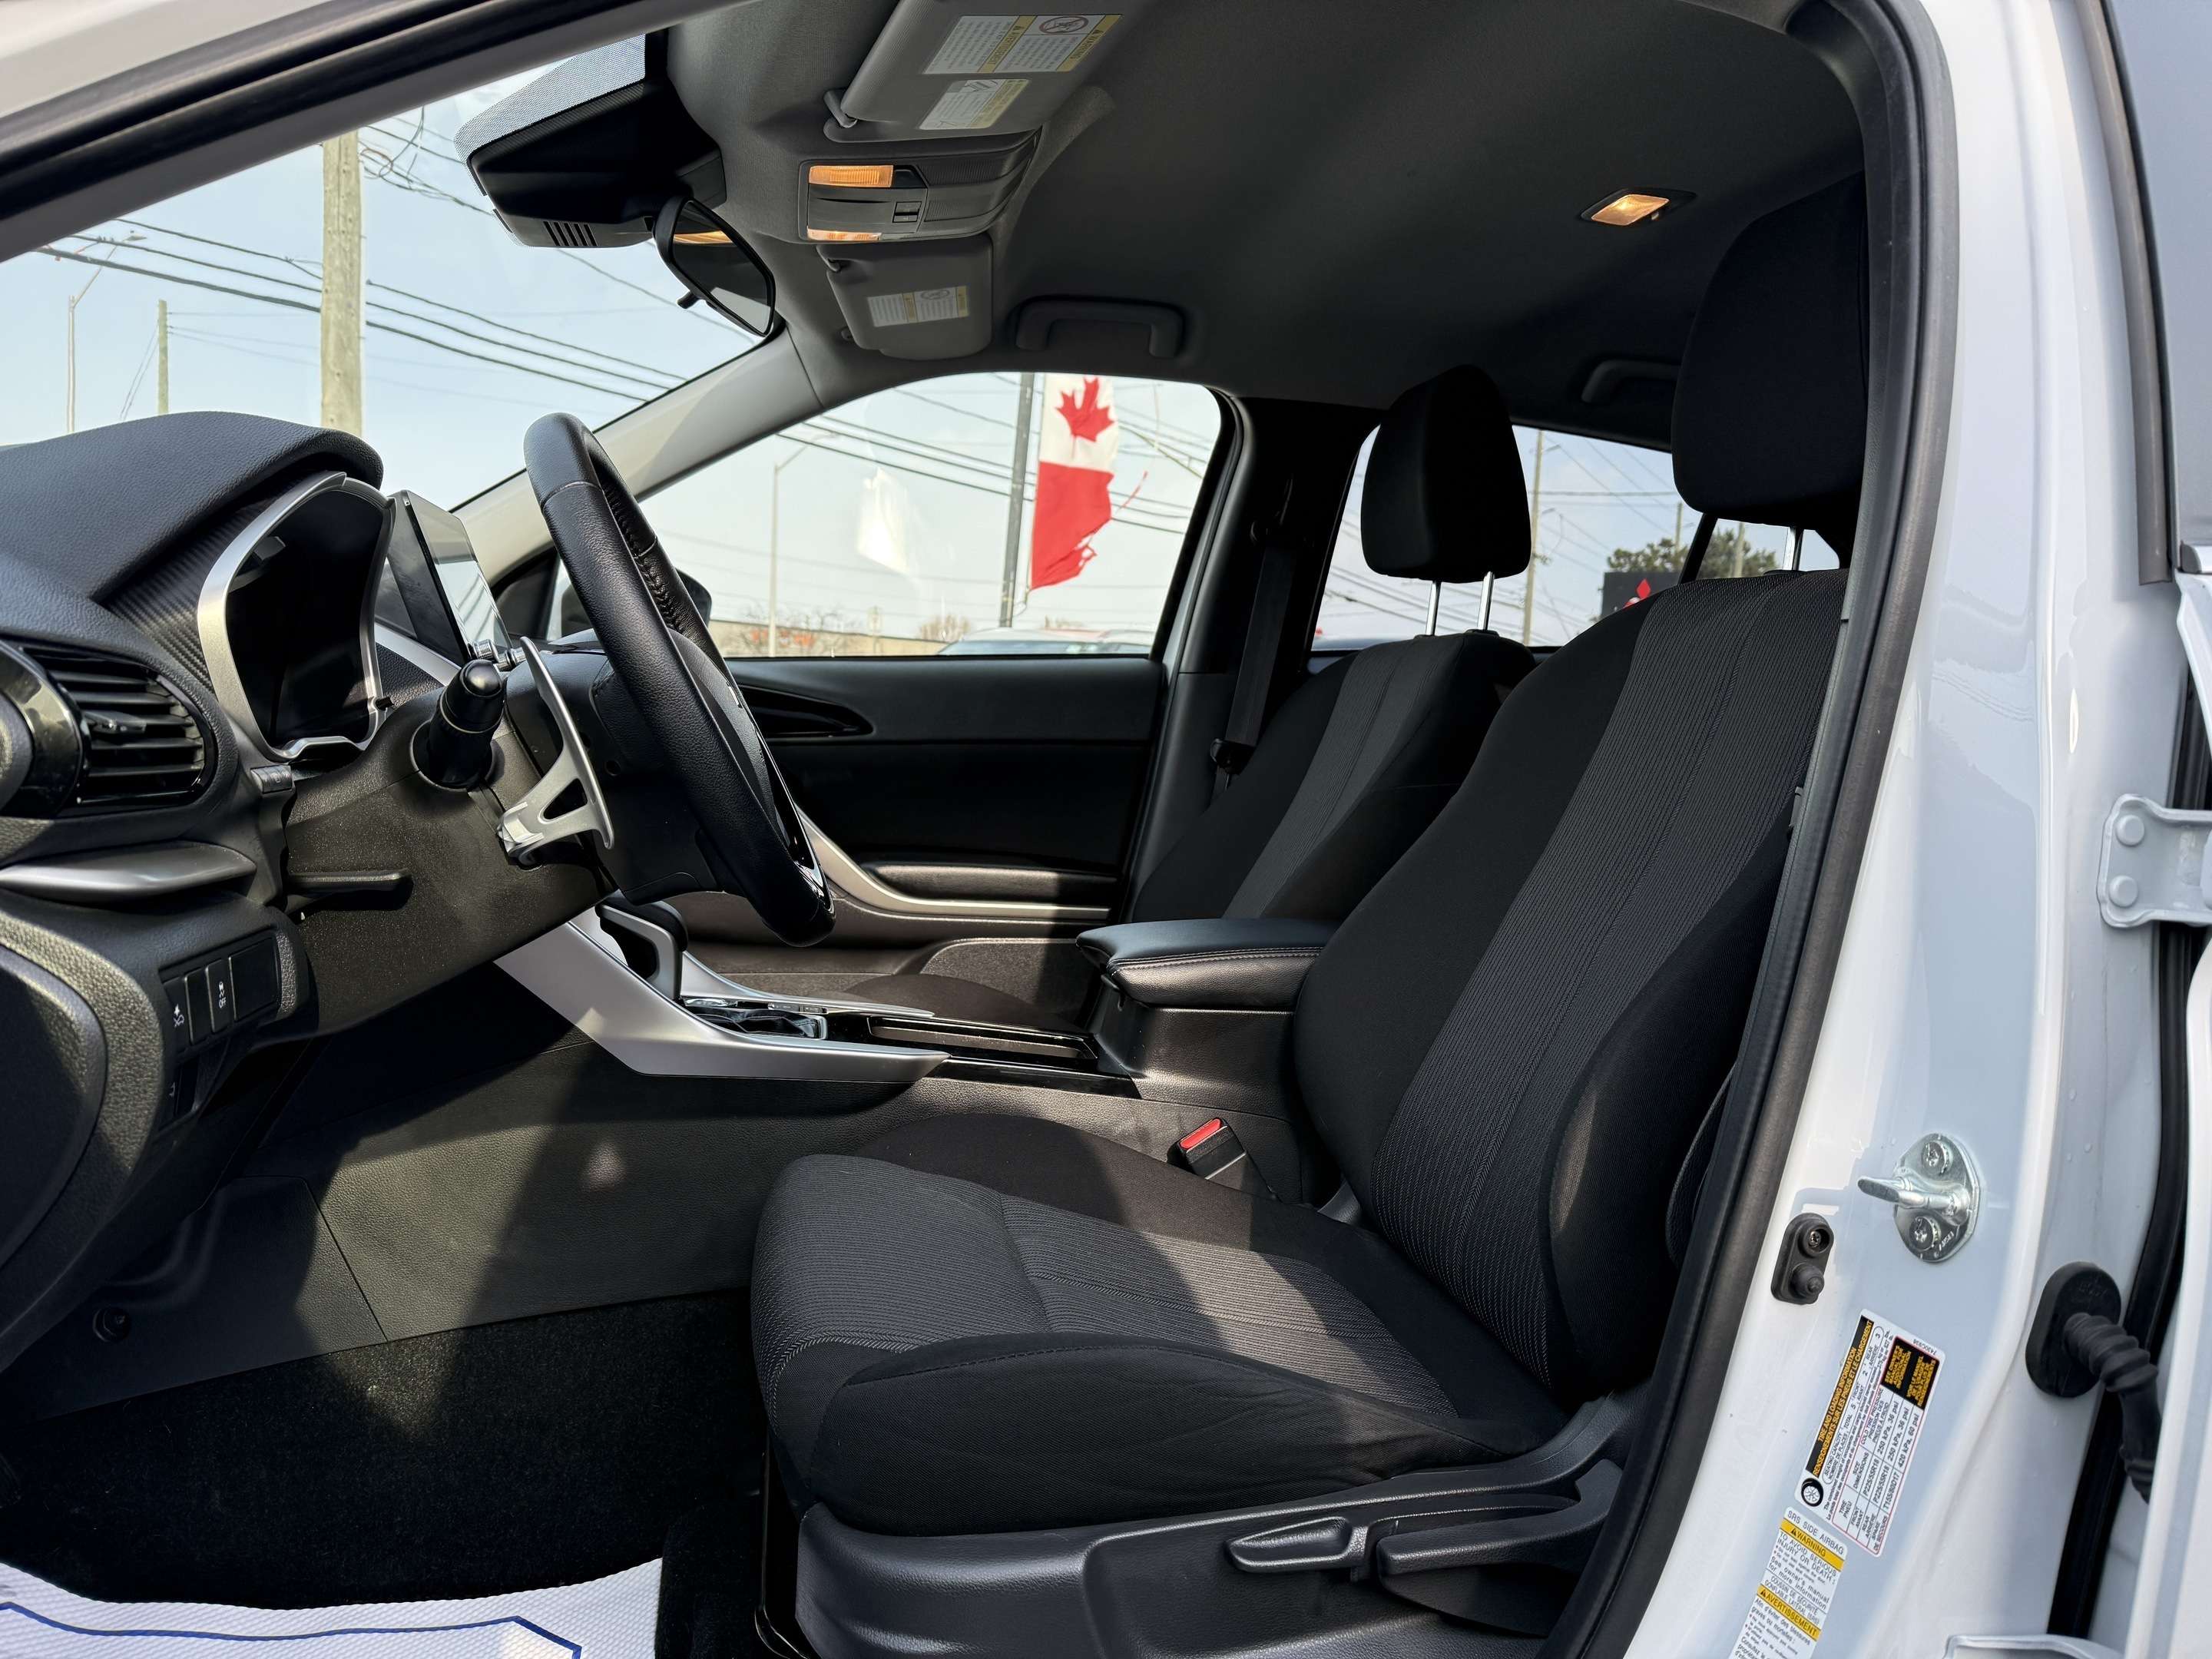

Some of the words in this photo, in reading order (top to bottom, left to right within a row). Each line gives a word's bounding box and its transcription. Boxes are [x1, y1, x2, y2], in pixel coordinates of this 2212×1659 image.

[1853, 1320, 1873, 1362] CHARGEMENT
[1850, 1359, 1859, 1370] LE
[1847, 1369, 1856, 1379] ET
[1817, 1426, 1827, 1442] TIRE
[1822, 1413, 1832, 1429] AND
[1827, 1386, 1842, 1415] LOADING
[1837, 1346, 1856, 1388] INFORMATION
[1840, 1376, 1853, 1399] PNEUS
[1836, 1397, 1845, 1412] LES
[1890, 1400, 1899, 1414] psi
[1900, 1406, 1910, 1420] psi
[1832, 1410, 1840, 1423] SUR
[1843, 1412, 1852, 1429] TOTAL
[1887, 1412, 1895, 1424] 36
[1897, 1419, 1905, 1430] 36
[1910, 1412, 1920, 1426] psi
[1907, 1425, 1915, 1436] 60
[1813, 1422, 1836, 1477] RENSEIGNEMENTS
[1876, 1439, 1886, 1455] 250
[1886, 1446, 1896, 1462] 250
[1896, 1452, 1906, 1468] 420
[1853, 1451, 1869, 1489] DIMENSIONS
[1839, 1498, 1847, 1515] TIRE
[1843, 1500, 1852, 1518] PNEU
[1786, 1510, 1800, 1524] SRS
[1802, 1521, 1818, 1536] SIDE
[1819, 1532, 1844, 1555] AIRBAG
[1777, 1537, 1798, 1557] INJURY
[1799, 1553, 1810, 1565] OR
[1795, 1530, 1826, 1557] WARNING
[1779, 1530, 1788, 1541] TO
[1789, 1538, 1807, 1555] AVOID
[1809, 1552, 1837, 1577] SERIOUS
[1768, 1561, 1777, 1572] for
[1778, 1570, 1793, 1584] more
[1794, 1582, 1826, 1611] information
[1770, 1555, 1782, 1568] See
[1807, 1583, 1830, 1604] manual
[1766, 1591, 1816, 1637] AVERTISSEMENT
